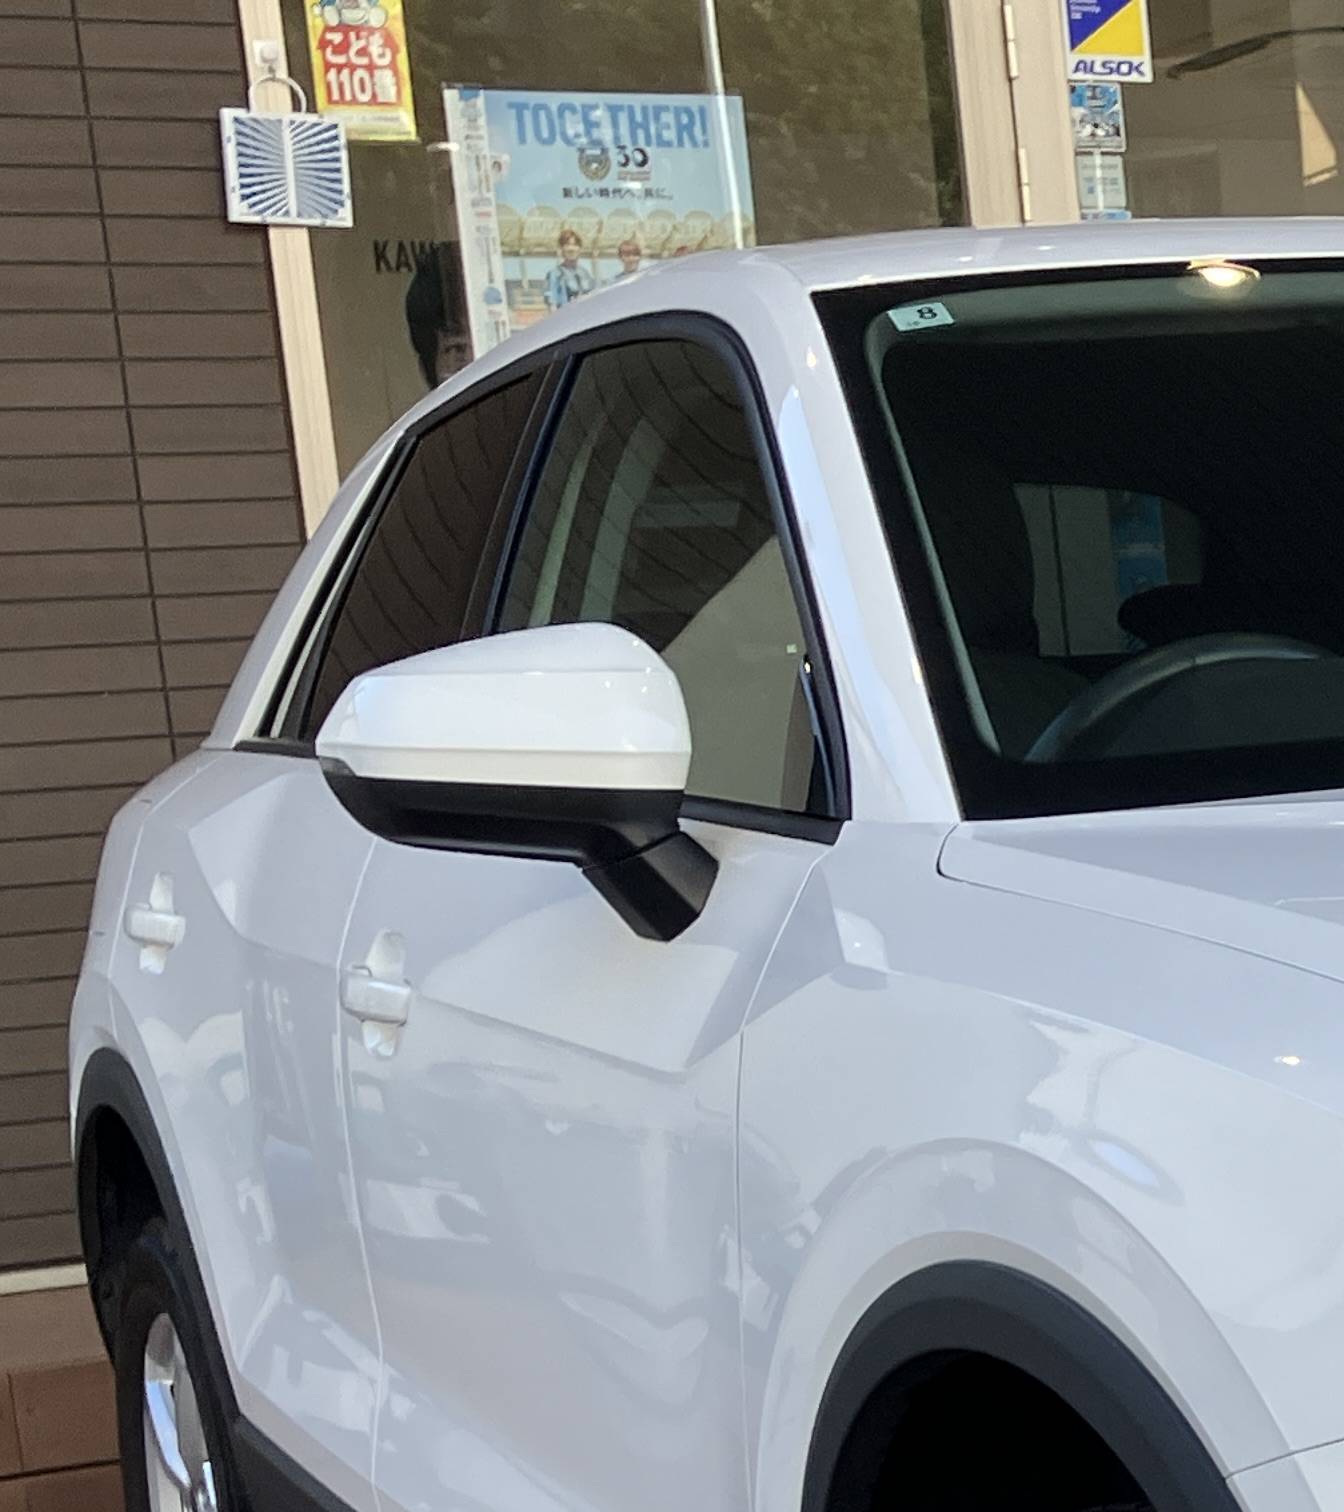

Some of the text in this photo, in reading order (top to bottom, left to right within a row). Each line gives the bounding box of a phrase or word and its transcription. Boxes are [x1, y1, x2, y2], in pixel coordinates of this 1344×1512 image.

[325, 31, 393, 67] こども
[326, 66, 397, 103] 110番
[1073, 59, 1145, 77] ALSOK
